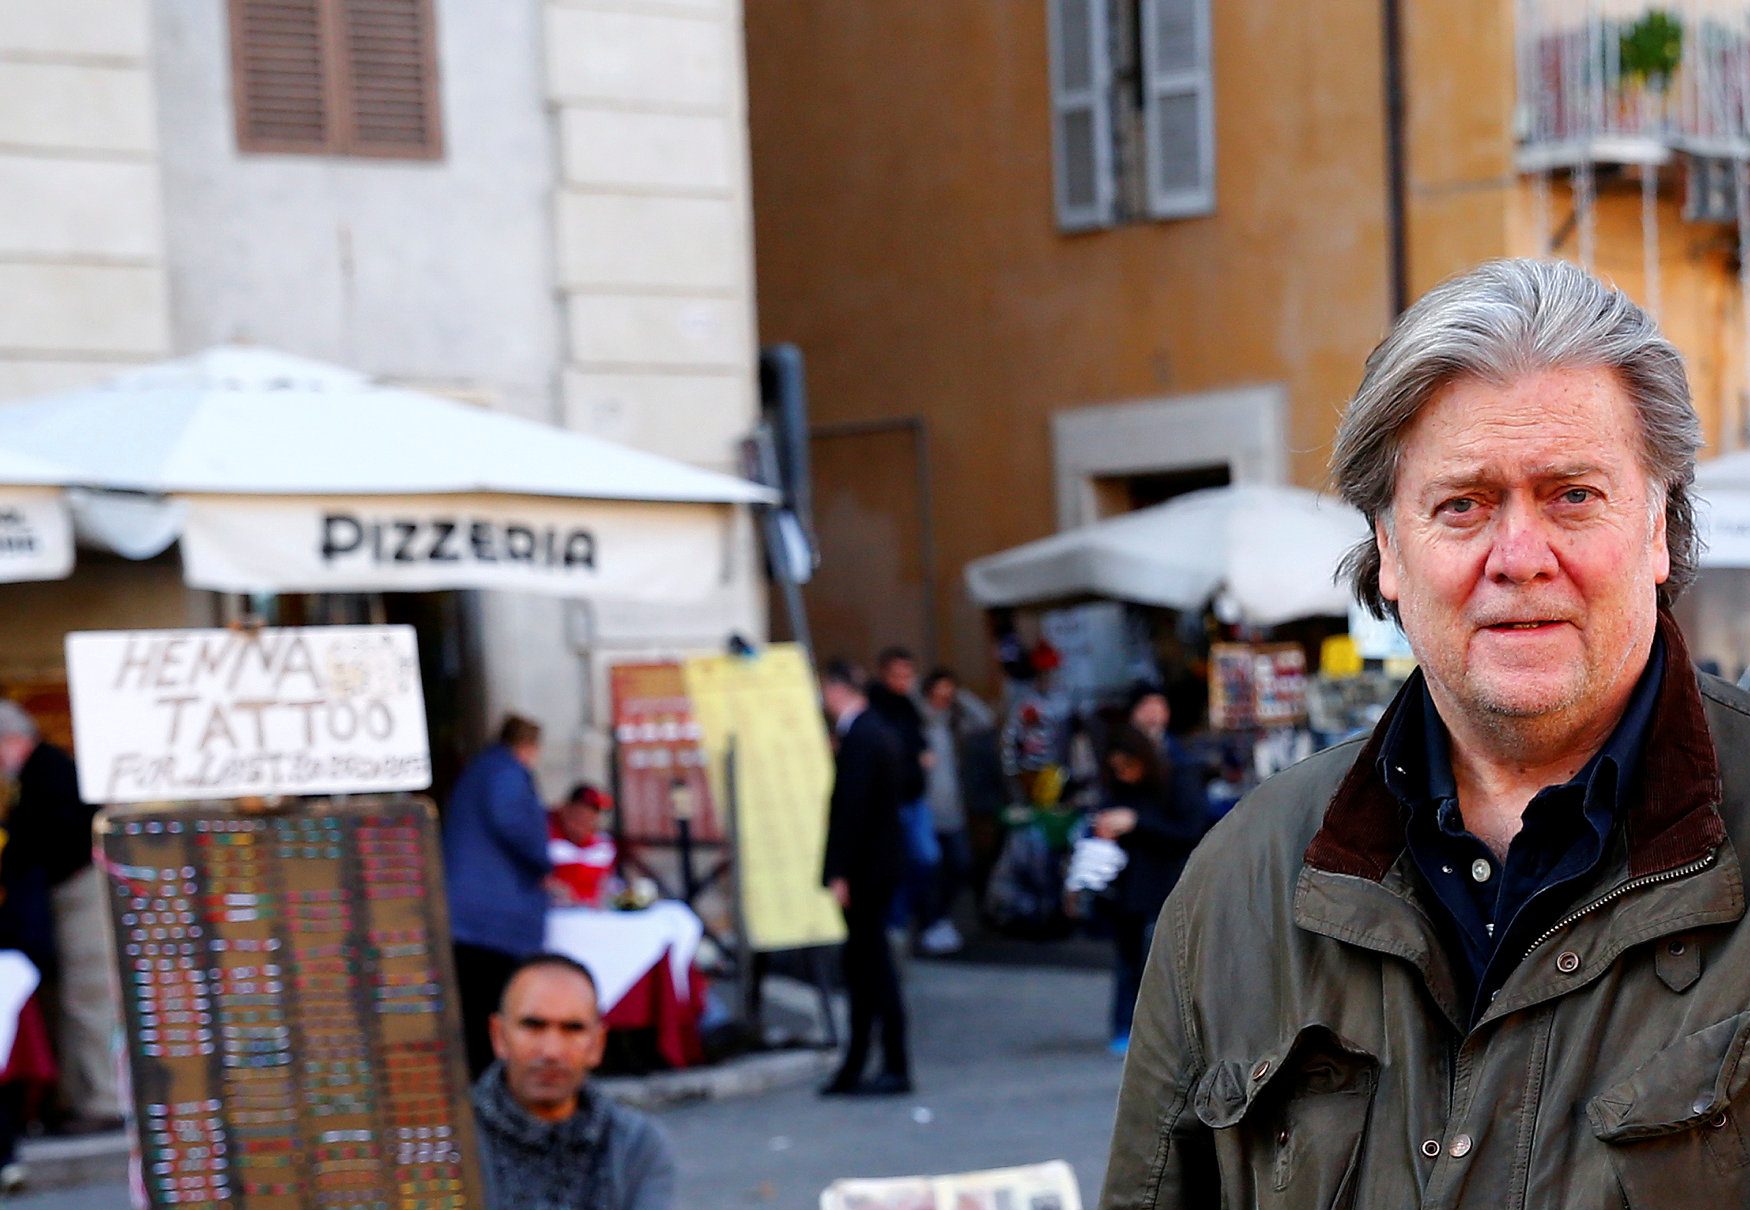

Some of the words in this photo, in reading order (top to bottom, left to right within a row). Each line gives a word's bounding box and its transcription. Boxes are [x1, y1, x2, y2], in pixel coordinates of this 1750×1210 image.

[321, 513, 596, 571] PIZZERIA
[113, 631, 322, 691] HENNA
[157, 696, 396, 750] TATTOO
